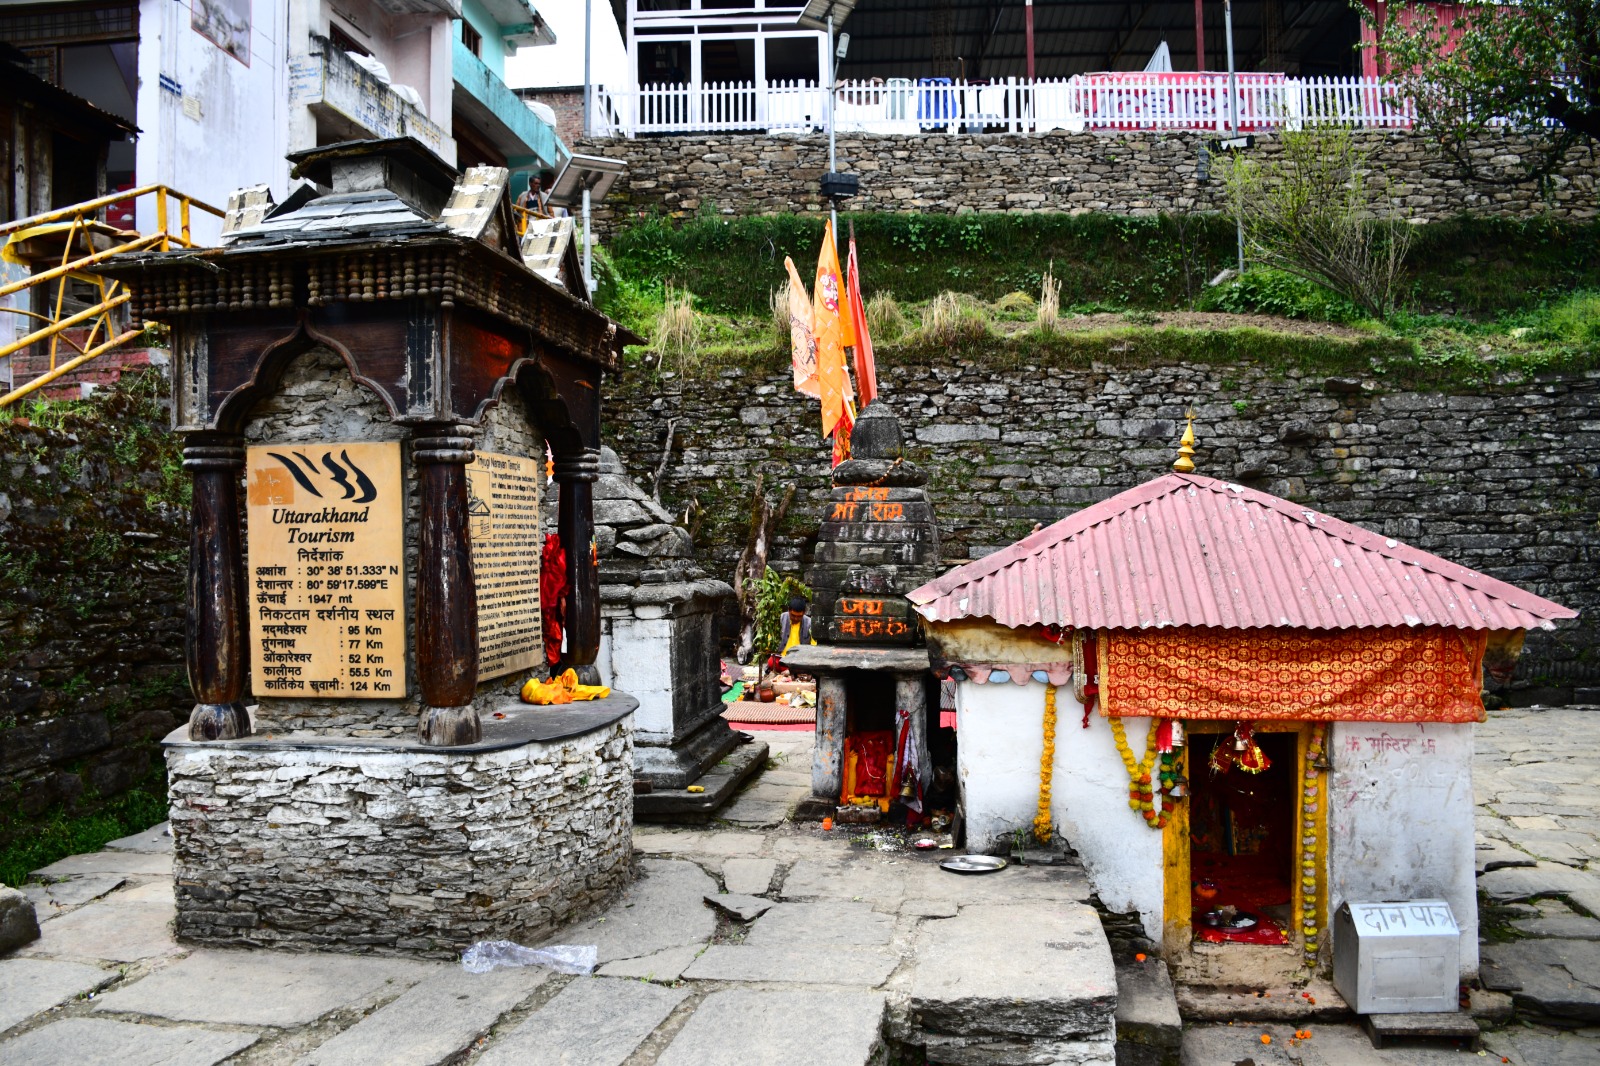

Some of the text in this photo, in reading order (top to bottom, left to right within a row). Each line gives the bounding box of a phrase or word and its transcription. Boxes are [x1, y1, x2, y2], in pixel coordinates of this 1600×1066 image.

[490, 457, 507, 470] Narayan
[507, 460, 520, 472] Temple
[272, 506, 370, 524] Uttarakhand
[872, 502, 903, 521] राम
[288, 528, 355, 544] Tourism
[297, 548, 344, 562] निर्देशांक
[256, 564, 287, 576] अक्षांश
[307, 566, 324, 576] 30°
[328, 566, 342, 576] 38'
[346, 566, 386, 576] 51.333"
[390, 566, 398, 575] N
[256, 577, 293, 590] देशान्तर
[307, 580, 324, 590] 80°
[308, 594, 333, 604] 1947
[339, 594, 352, 604] mt
[259, 606, 396, 621] निकटतम दर्शनीय स्थल
[842, 599, 883, 615] जय
[348, 626, 360, 635] 95
[366, 625, 382, 635] Km
[261, 636, 296, 651] तुंगनाथ
[348, 640, 360, 649] 77
[366, 640, 383, 649] Km
[349, 654, 361, 664] 52
[366, 654, 384, 664] Km
[263, 664, 302, 676] कालीमठ
[350, 668, 370, 677] 55.5
[376, 668, 392, 677] Km
[264, 677, 304, 690] कार्तिकेय
[350, 682, 368, 690] 124
[374, 682, 390, 691] Km
[1364, 731, 1416, 755] मन्दिर
[1359, 905, 1456, 932] दान पात्र
